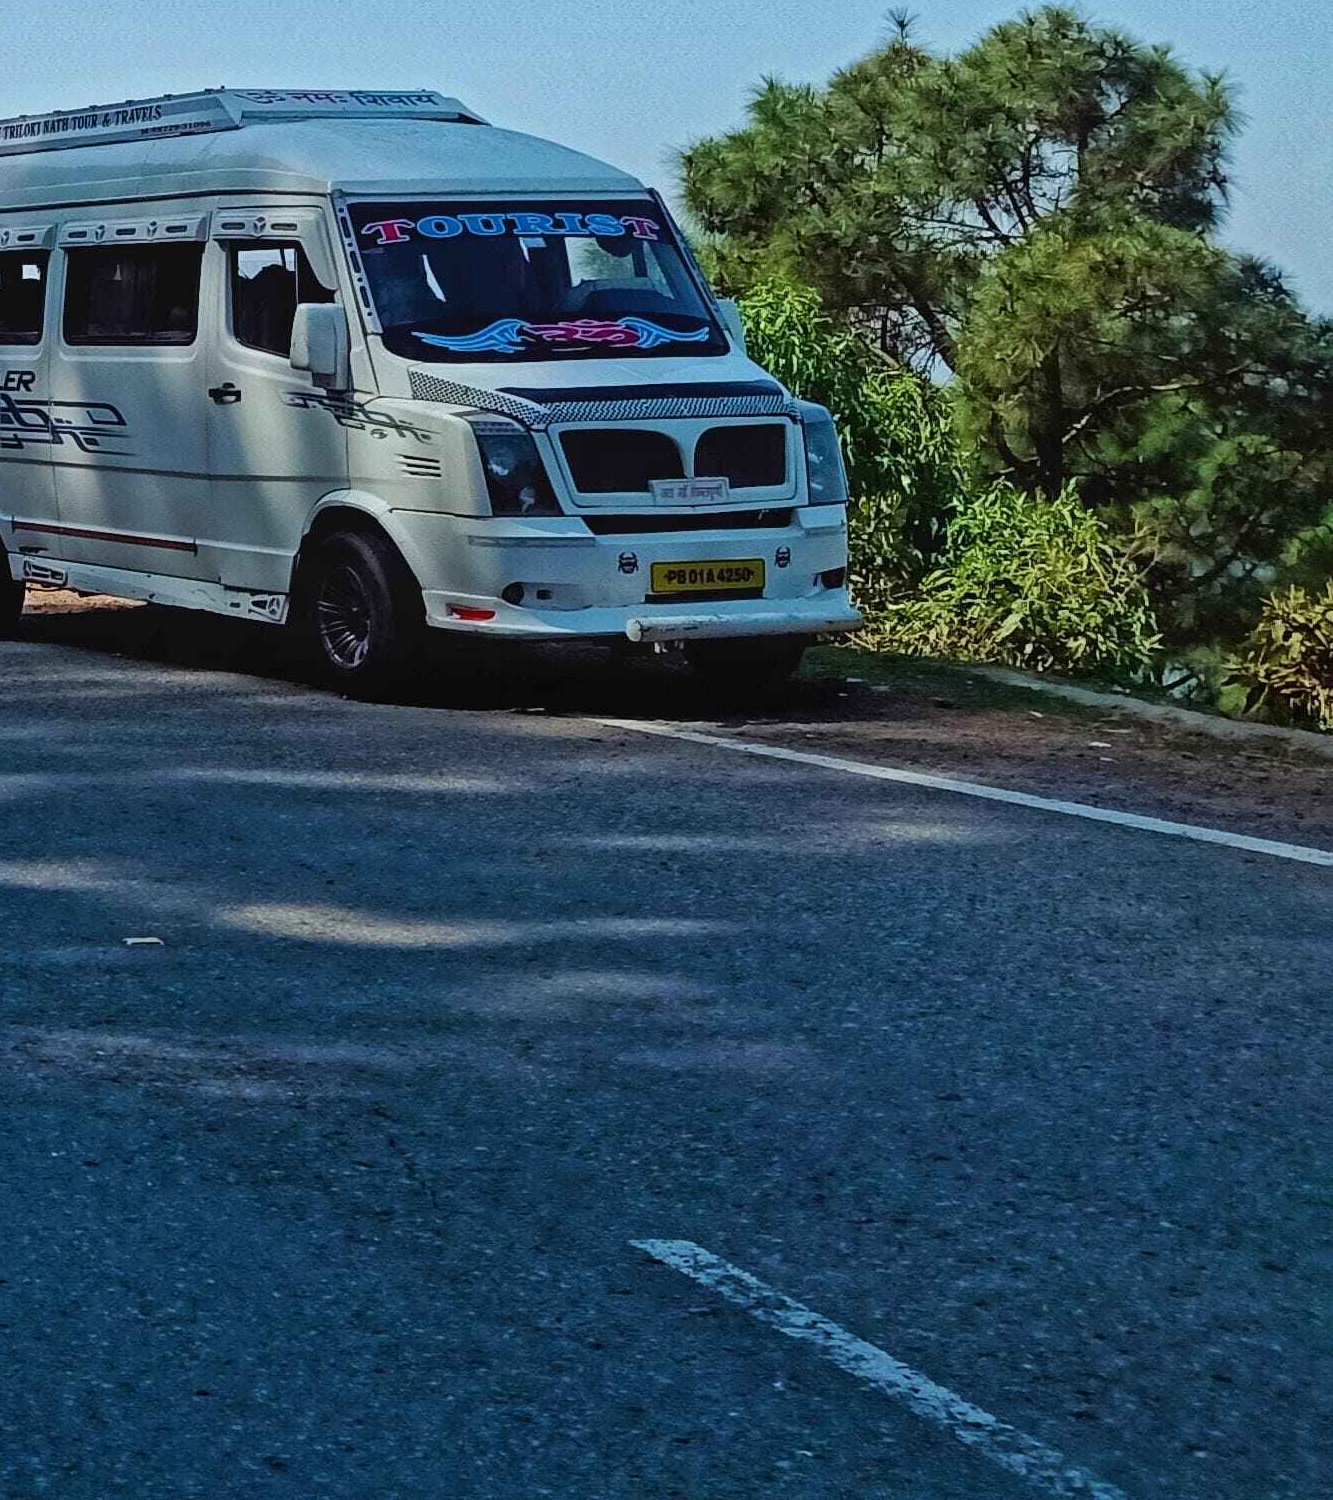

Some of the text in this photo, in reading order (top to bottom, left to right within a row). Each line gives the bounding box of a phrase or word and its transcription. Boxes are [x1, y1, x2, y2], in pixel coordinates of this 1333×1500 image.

[3, 121, 42, 141] TRILOKI
[42, 115, 71, 135] NATH
[71, 113, 98, 131] TOUR
[101, 112, 111, 128] &
[114, 104, 163, 126] TRAVELS
[361, 212, 660, 245] TOURIST
